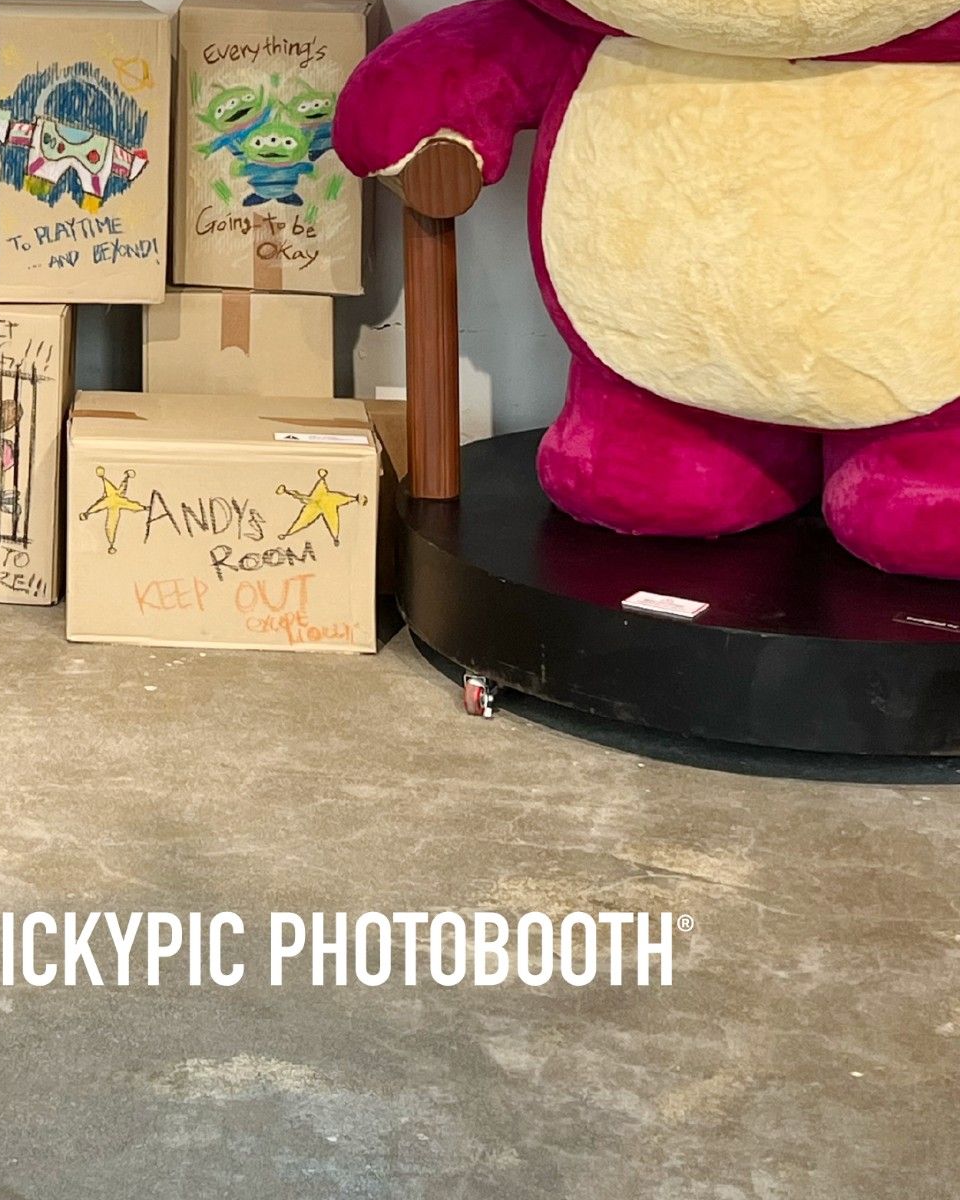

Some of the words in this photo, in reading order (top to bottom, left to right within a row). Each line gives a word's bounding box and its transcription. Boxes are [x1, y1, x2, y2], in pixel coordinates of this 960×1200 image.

[203, 36, 328, 69] Everything's
[33, 216, 123, 246] PLAYTIME
[195, 205, 252, 235] Going
[263, 212, 286, 236] to
[292, 214, 318, 238] be
[134, 576, 209, 615] KEEP
[235, 572, 316, 613] OUT
